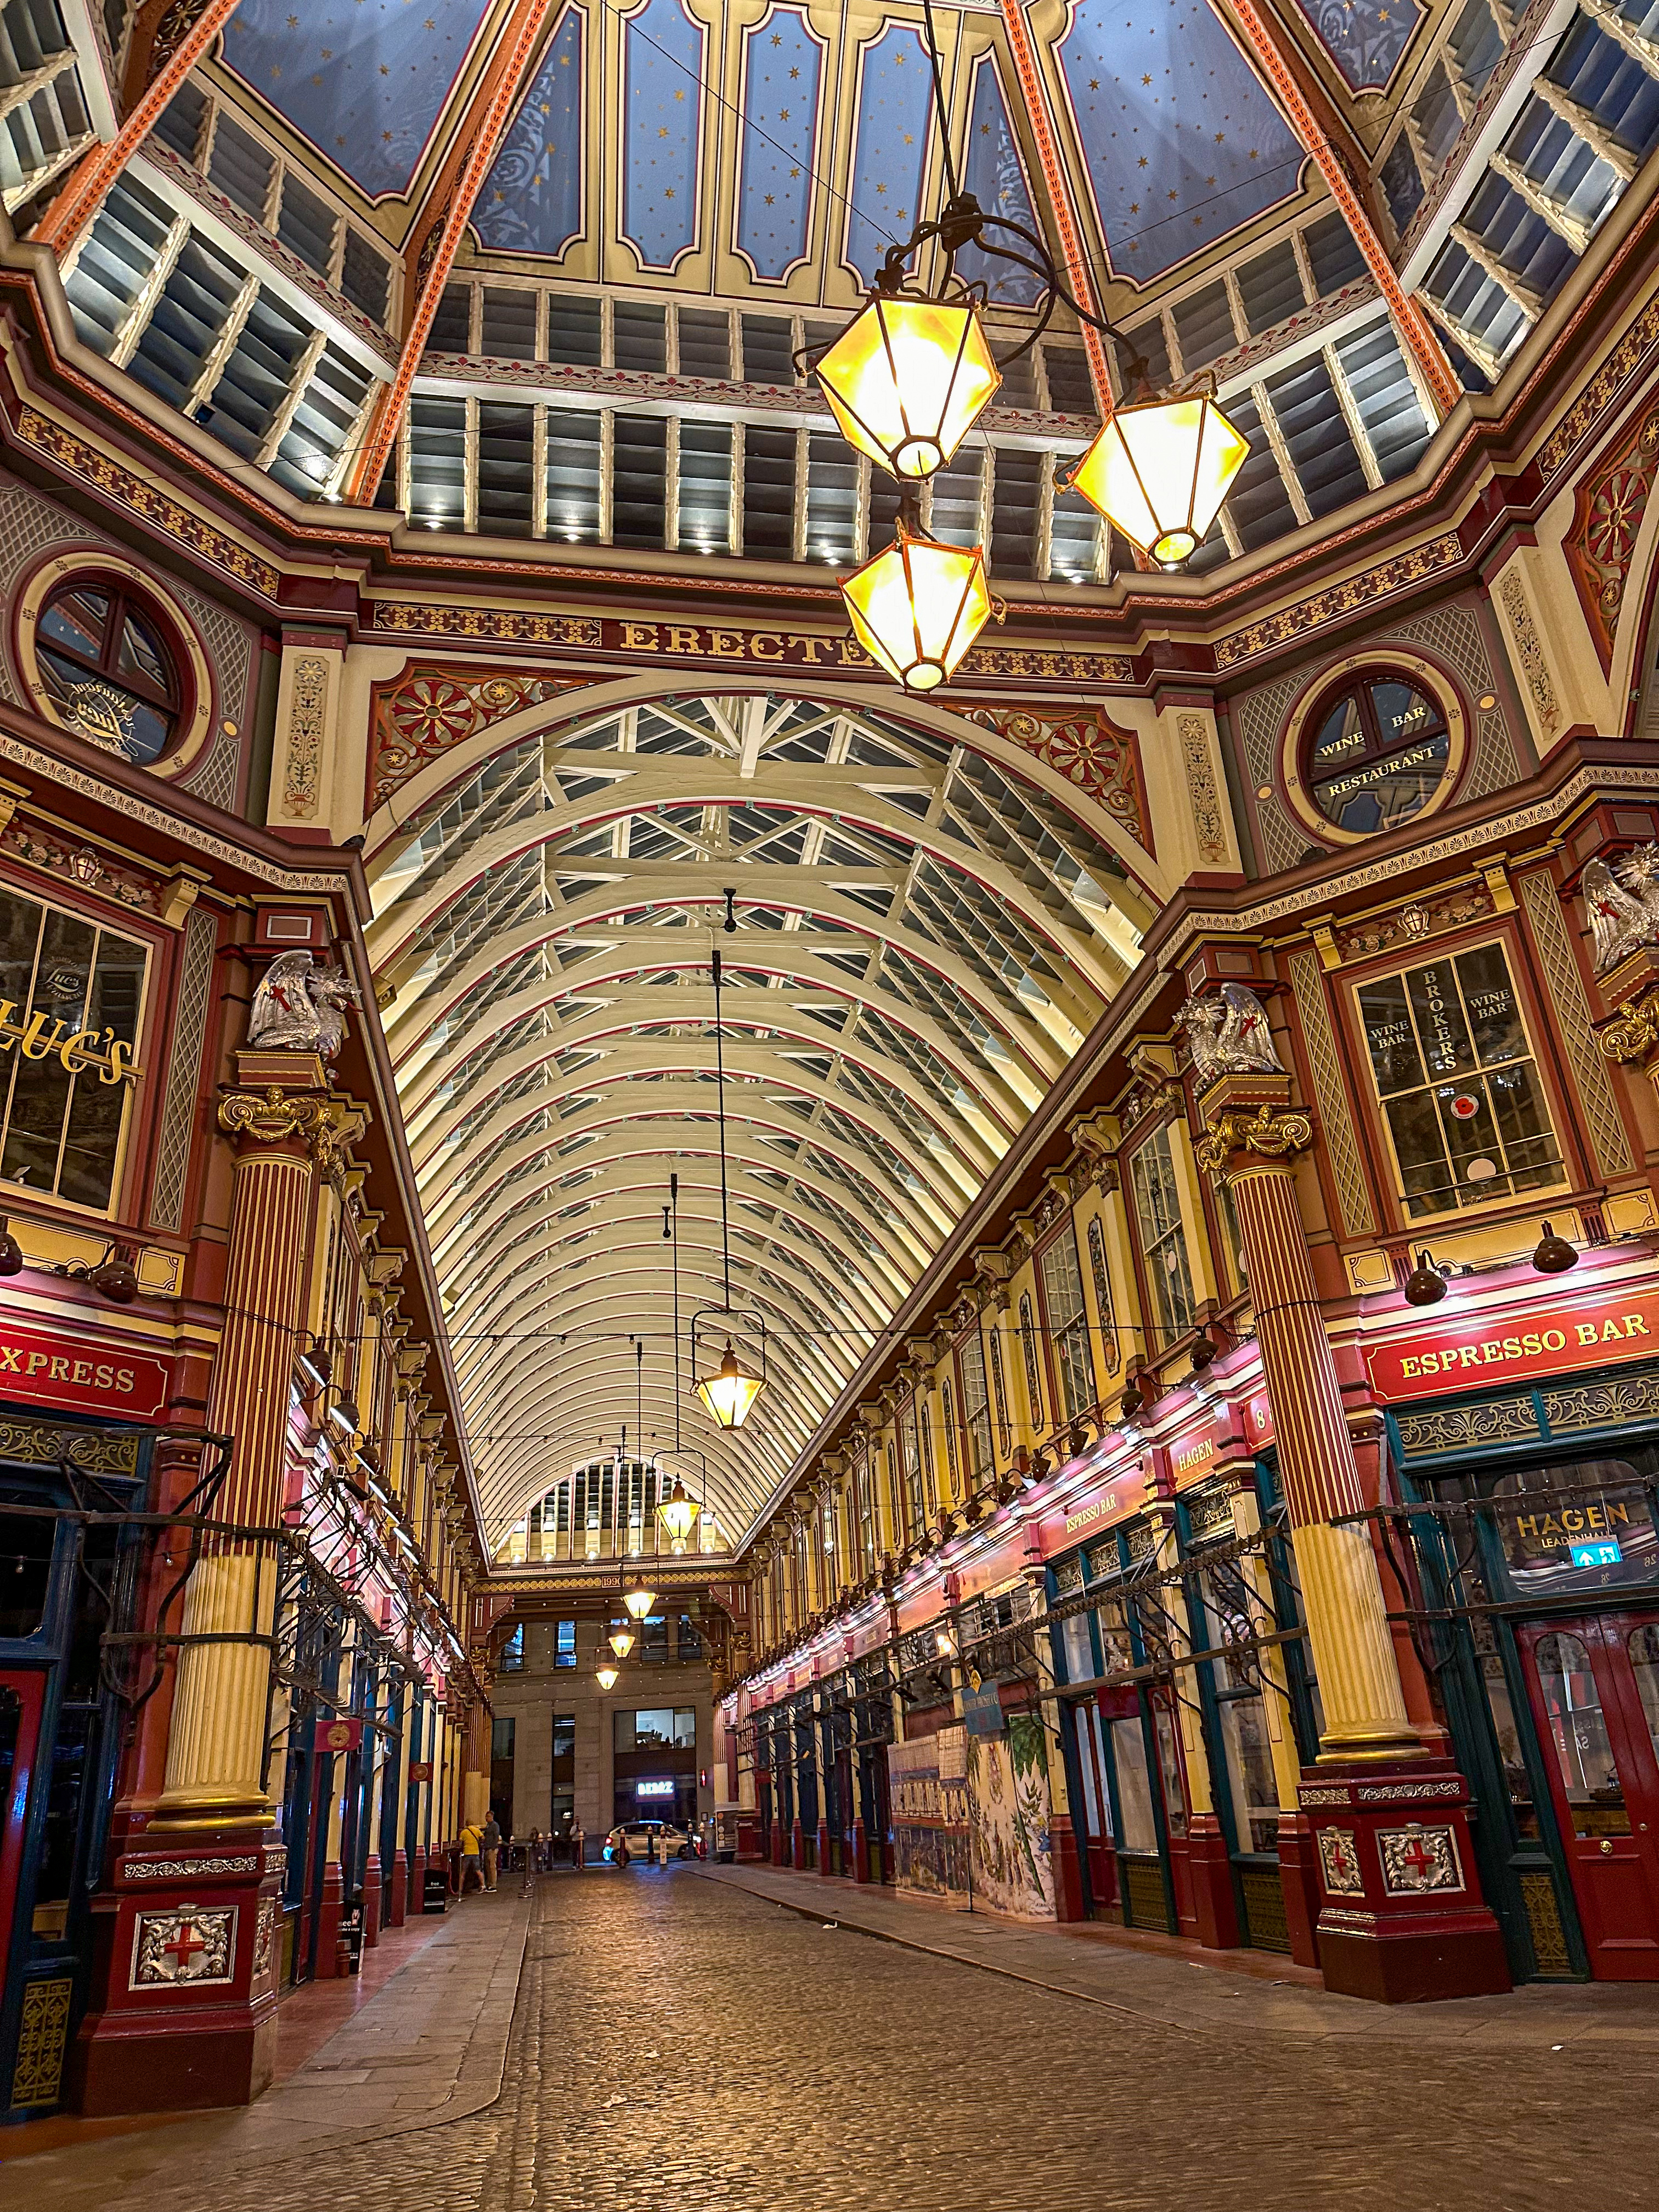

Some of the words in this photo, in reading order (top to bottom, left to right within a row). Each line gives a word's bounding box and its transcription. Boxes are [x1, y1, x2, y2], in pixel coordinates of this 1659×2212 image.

[619, 622, 875, 667] ERECTE
[1319, 731, 1364, 757] WINE
[1391, 706, 1426, 728] BAR
[1328, 745, 1436, 797] RESTAURANT
[1470, 989, 1510, 1009] WINE
[1477, 1002, 1508, 1019] BAR
[1370, 1020, 1409, 1039] WINE
[1423, 970, 1457, 1070] BROKERS
[1378, 1033, 1407, 1049] BAR
[1400, 1329, 1567, 1380] ESPRESSO
[1575, 1313, 1651, 1347] BAR
[1178, 1438, 1214, 1472] HAGEN
[1066, 1503, 1101, 1534] ESPRESSO
[1100, 1493, 1117, 1515] BAR
[1516, 1503, 1629, 1538] HAGEN
